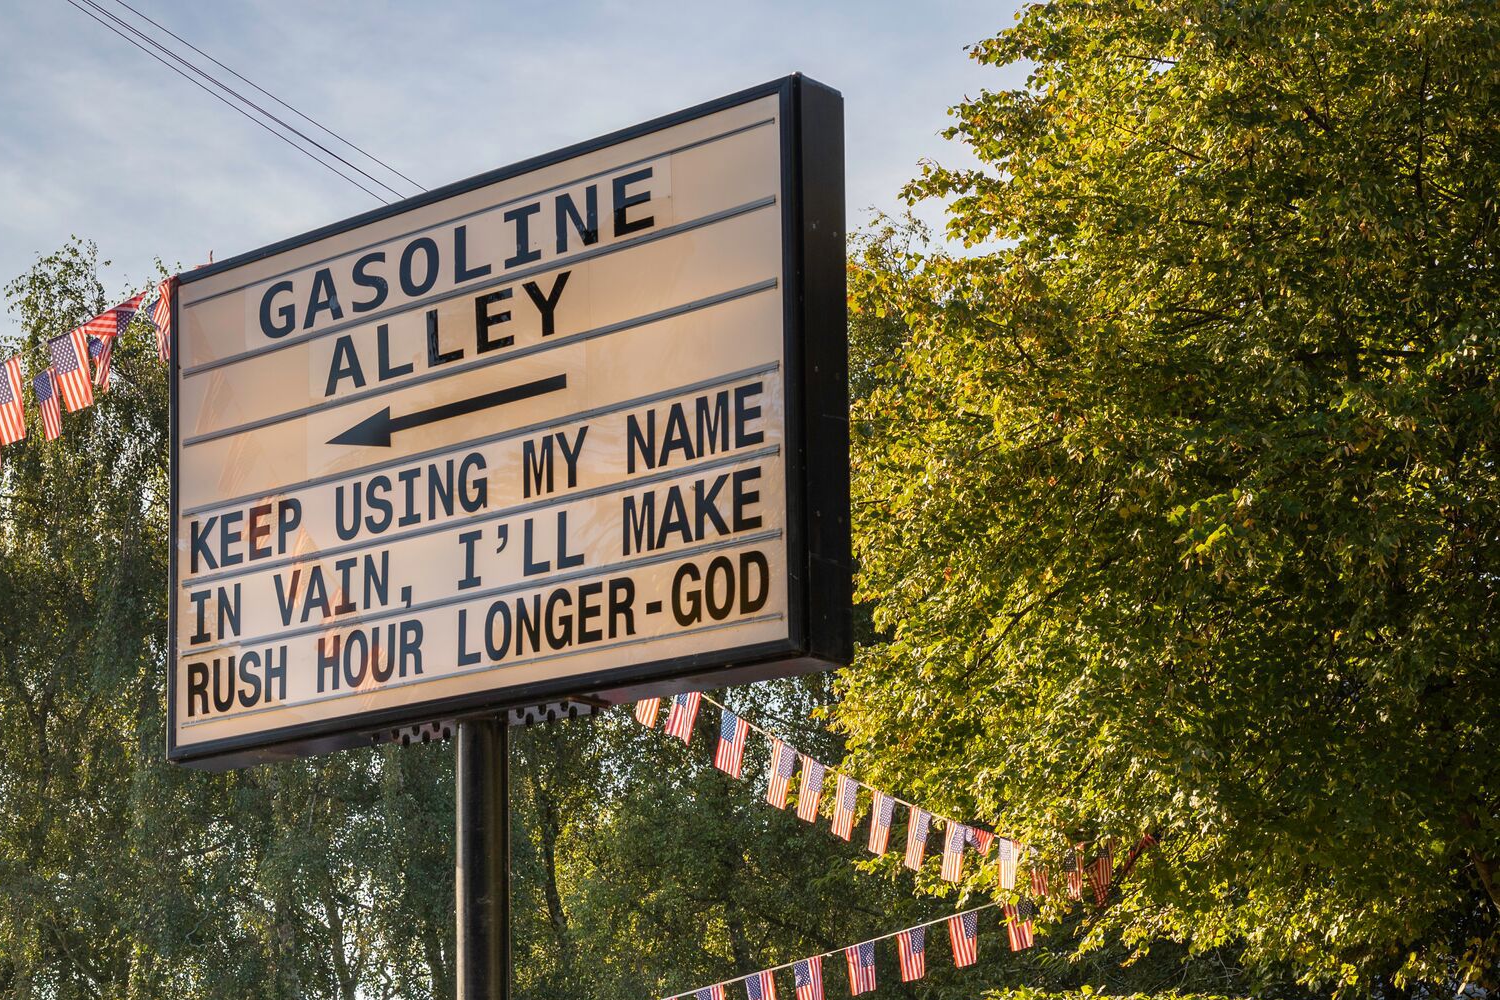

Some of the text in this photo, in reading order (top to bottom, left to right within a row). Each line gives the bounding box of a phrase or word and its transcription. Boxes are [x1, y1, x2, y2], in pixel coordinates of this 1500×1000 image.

[258, 166, 656, 339] GASOLINE
[324, 270, 572, 397] ALLEY
[190, 381, 764, 574] KEEP USING MY NAME
[190, 466, 762, 646] IN VAIN, I'LL MAKE
[187, 550, 770, 717] RUSH HOUR LONGER-GOD
